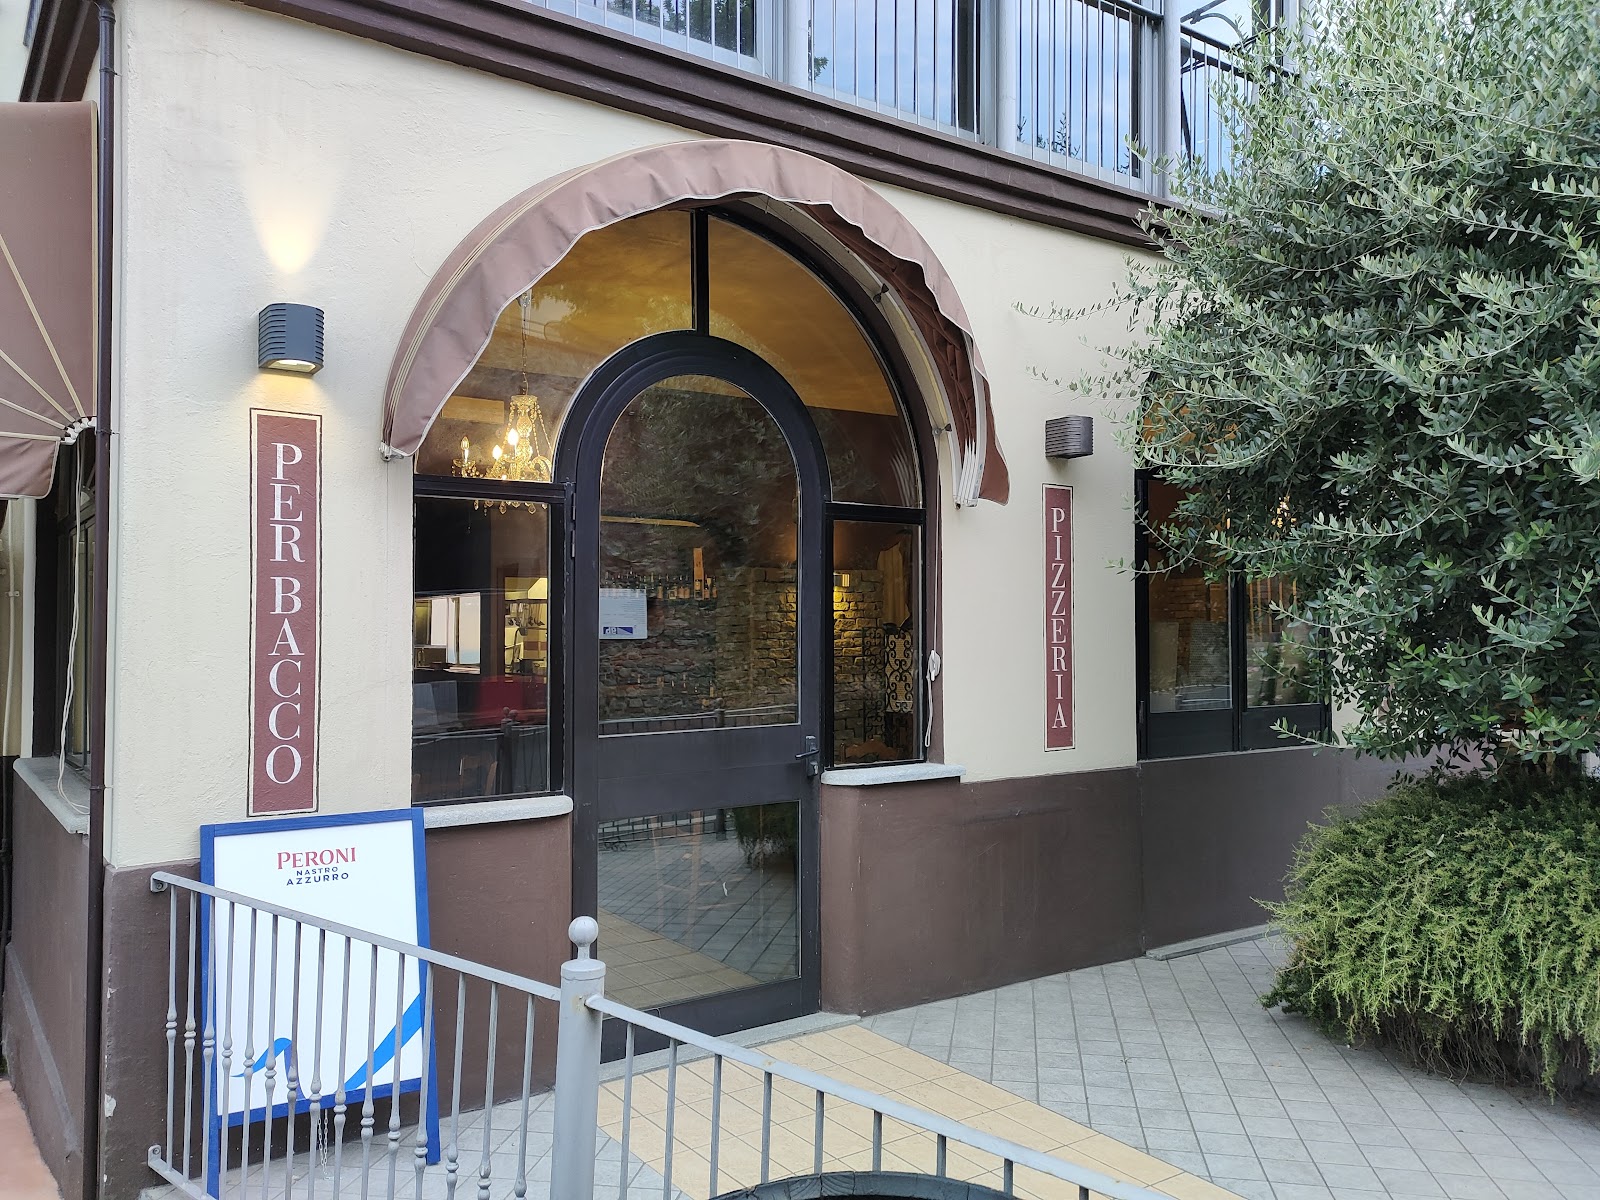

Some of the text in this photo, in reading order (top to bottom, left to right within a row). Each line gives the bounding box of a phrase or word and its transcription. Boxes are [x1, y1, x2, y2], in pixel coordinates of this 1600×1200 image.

[265, 441, 305, 785] PER BACCO
[1051, 507, 1068, 729] PIZZERIA
[277, 847, 356, 870] PERONI
[286, 872, 349, 886] AZZURRO
[296, 866, 339, 876] NASTRO
